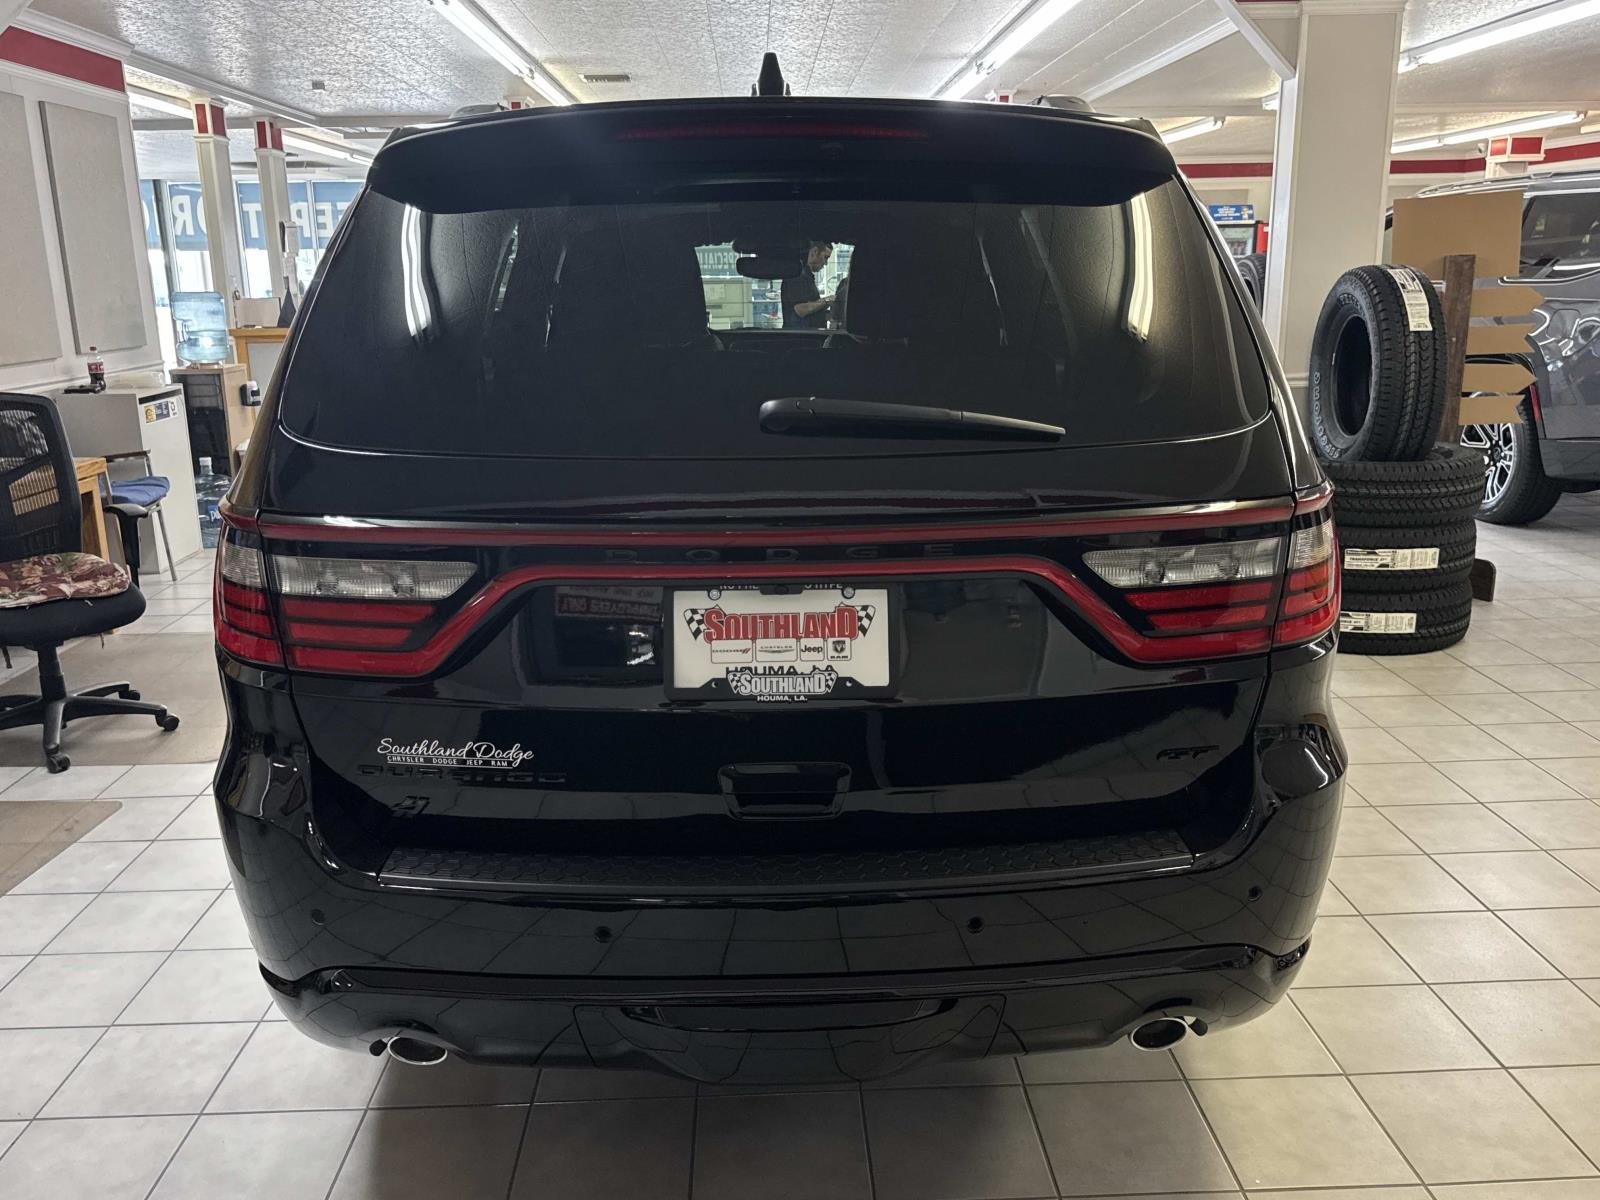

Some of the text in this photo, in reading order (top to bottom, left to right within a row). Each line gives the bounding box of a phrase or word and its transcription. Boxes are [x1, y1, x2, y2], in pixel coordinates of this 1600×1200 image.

[604, 544, 955, 563] DODGE
[801, 644, 823, 654] Jeep
[756, 694, 791, 703] HOUMA,
[377, 737, 534, 767] Southland Dodge
[387, 755, 424, 763] CHRYSLER
